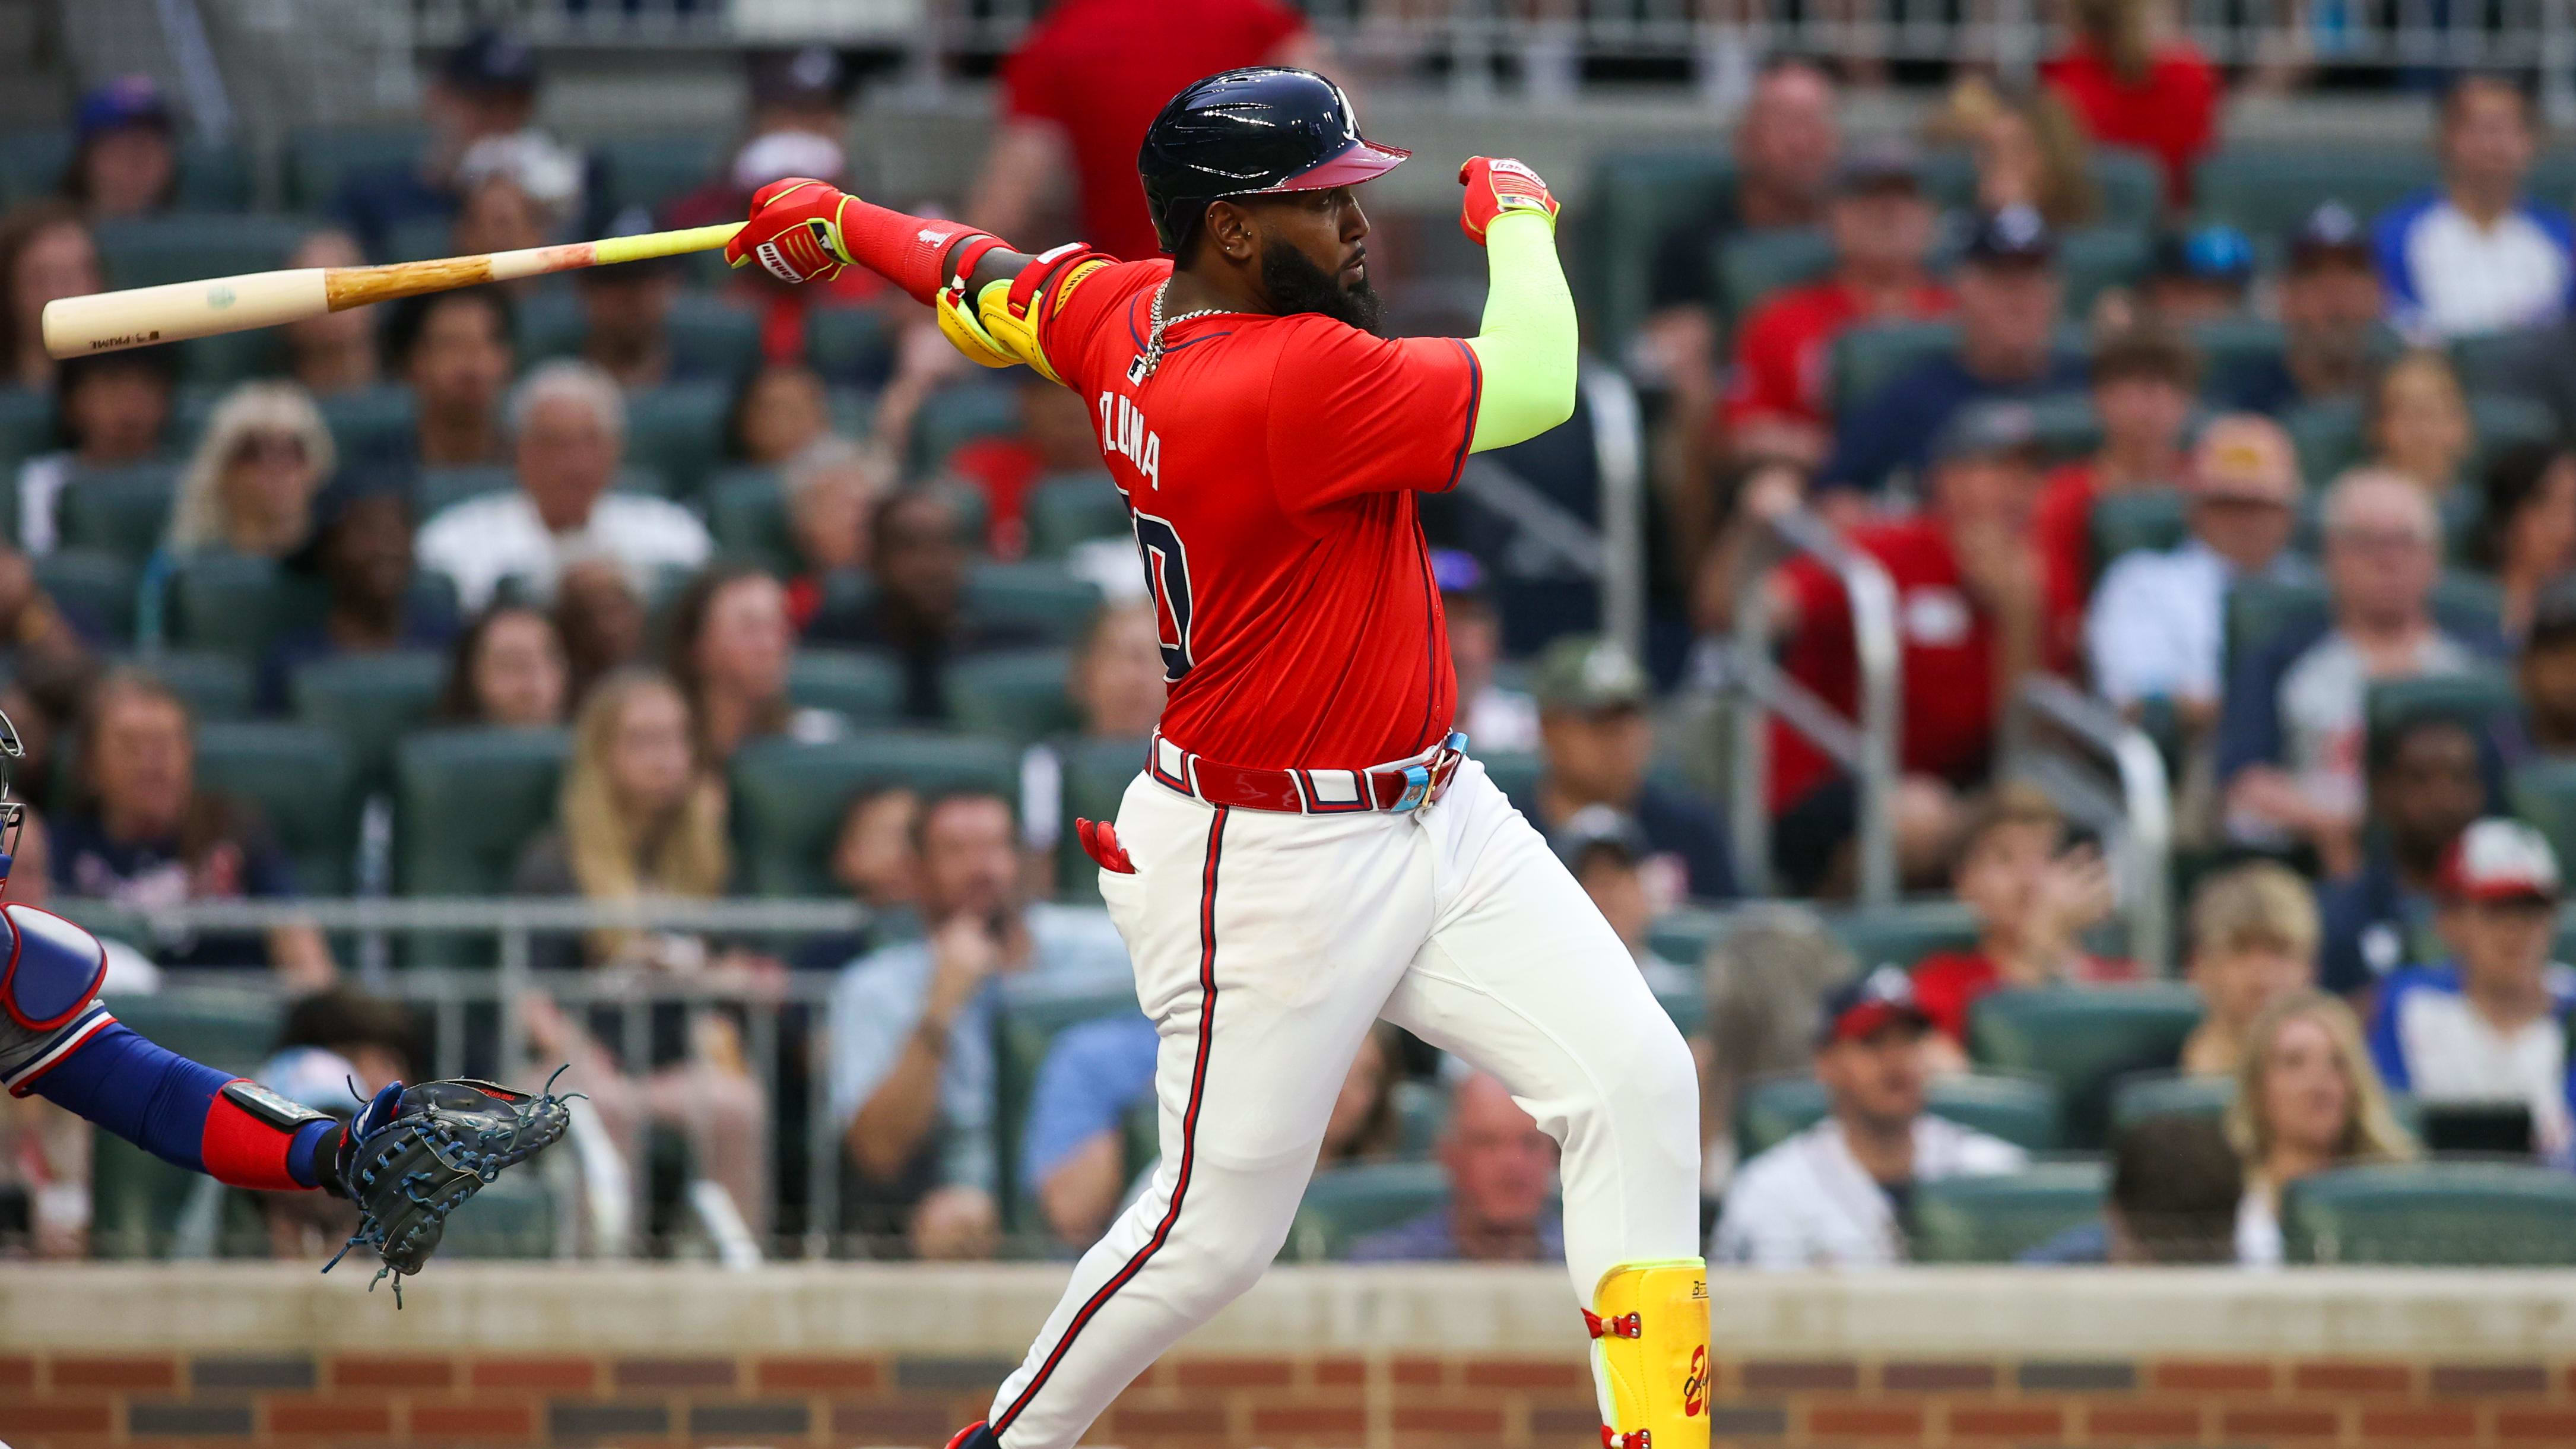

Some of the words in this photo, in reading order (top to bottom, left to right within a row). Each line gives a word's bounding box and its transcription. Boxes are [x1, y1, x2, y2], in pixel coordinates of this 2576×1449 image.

[1099, 391, 1160, 492] ZUNA
[1114, 481, 1197, 683] 0
[1684, 1344, 1711, 1417] 2
